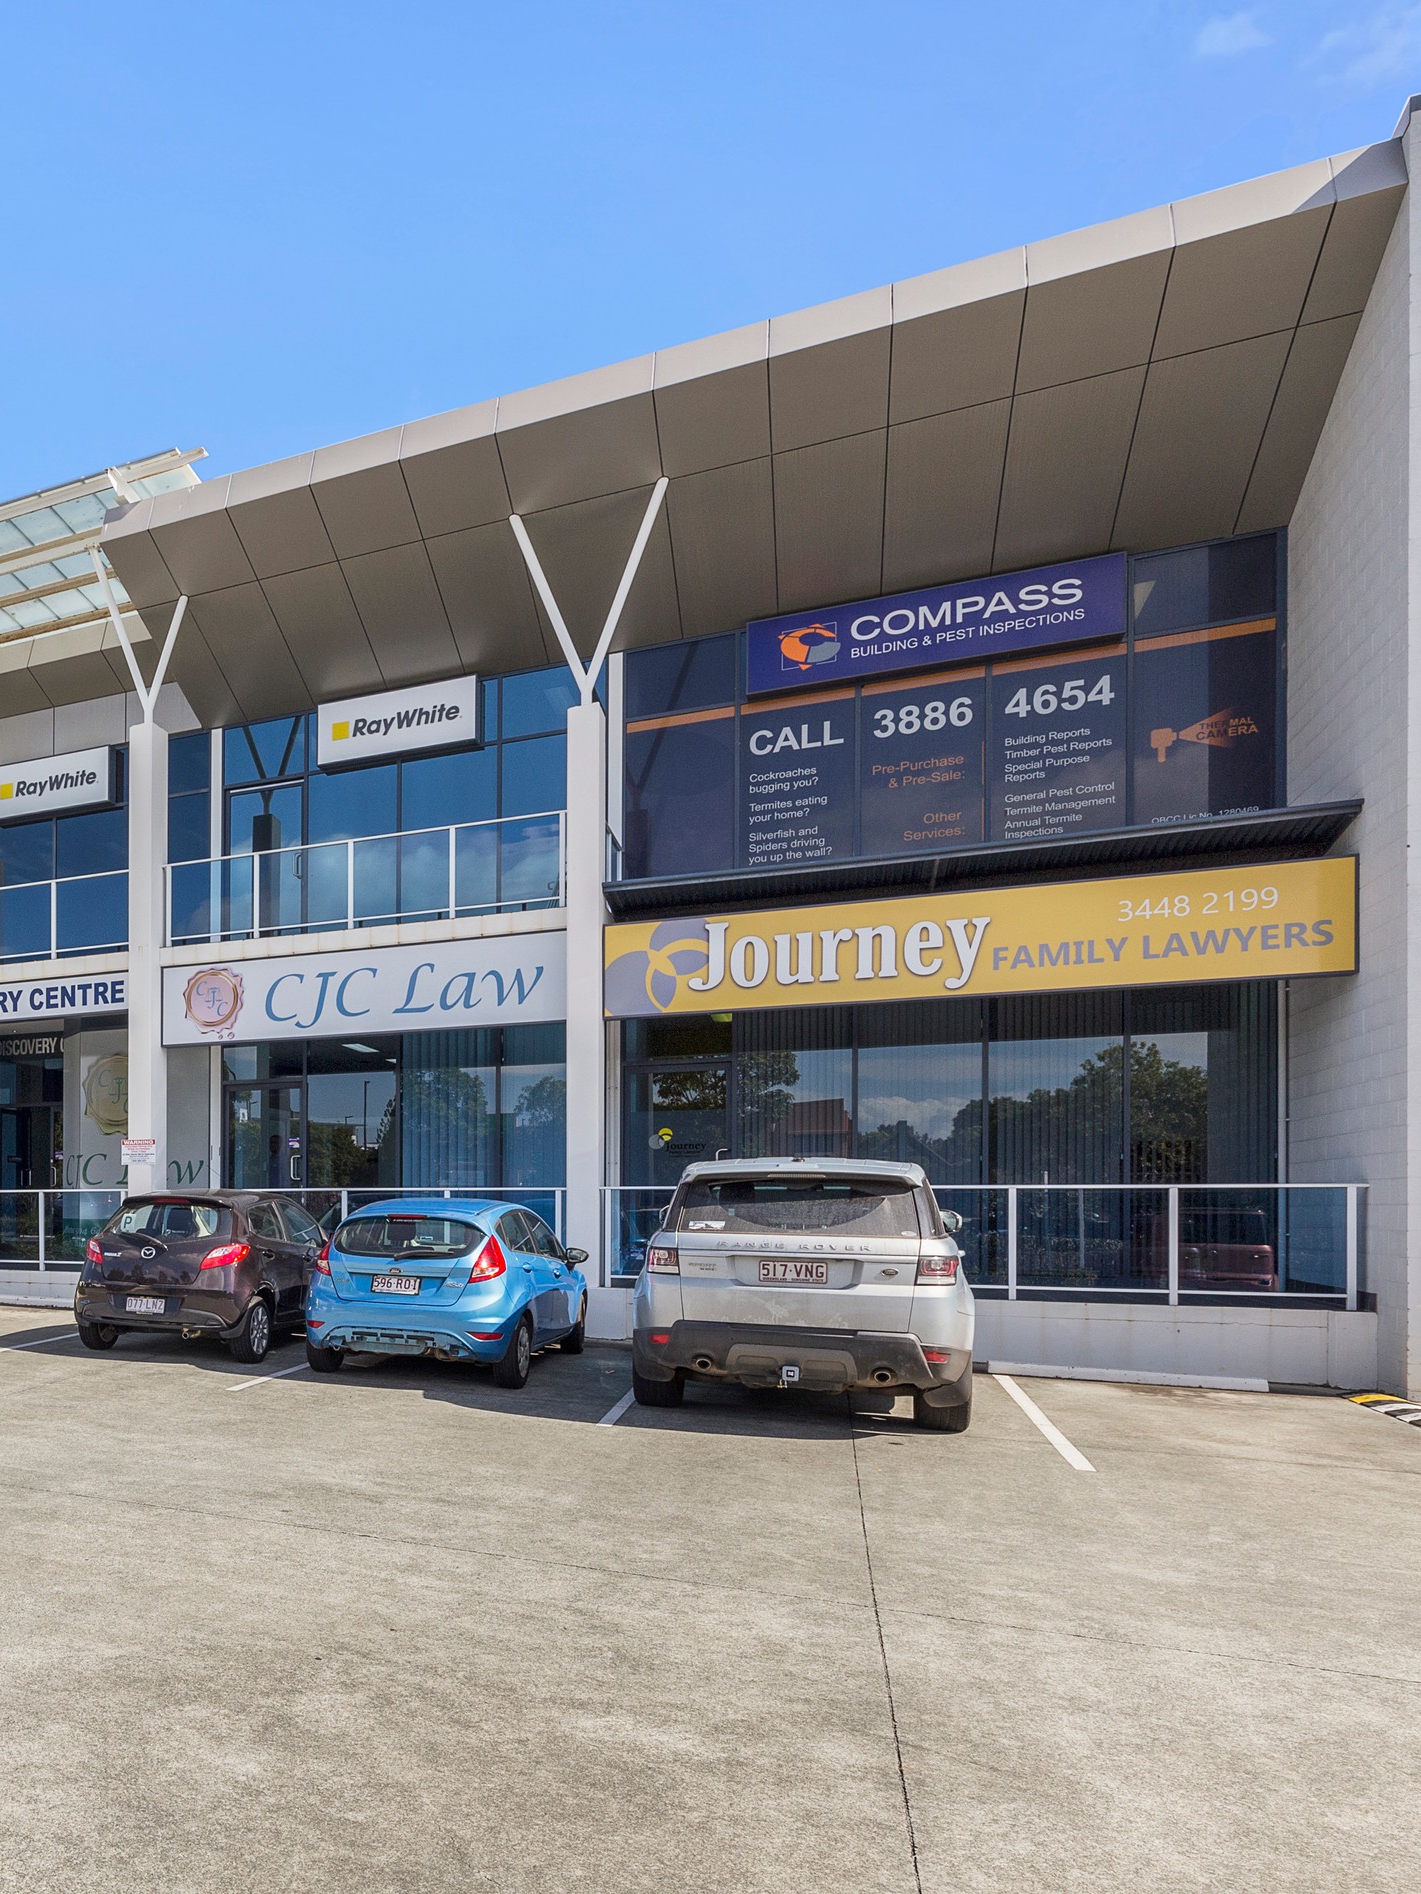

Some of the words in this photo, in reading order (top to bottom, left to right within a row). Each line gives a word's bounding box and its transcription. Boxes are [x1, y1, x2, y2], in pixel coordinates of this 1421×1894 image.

[851, 578, 1083, 641] COMPASS
[851, 637, 918, 658] BUILDING
[922, 635, 932, 646] &
[936, 627, 975, 644] PEST
[979, 608, 1085, 637] INSPECTIONS
[1005, 675, 1115, 718] 4654
[352, 703, 461, 738] RayWhite
[873, 697, 973, 739] 3886
[749, 721, 844, 756] CALL
[1005, 734, 1046, 747] Building
[1049, 728, 1091, 741] Reports
[1005, 748, 1041, 759] Timber
[1044, 743, 1067, 755] Pest
[1070, 738, 1112, 751] Reports
[872, 754, 965, 776] Pre-Purchase
[1005, 761, 1043, 773] Special
[1046, 755, 1090, 768] Purpose
[15, 768, 98, 798] RayWhite
[749, 767, 817, 783] Cockroaches
[888, 777, 899, 789] &
[902, 770, 966, 787] Pre-Sale:
[1005, 770, 1046, 783] Reports
[749, 781, 790, 794] bugging
[793, 776, 819, 791] you?
[1005, 789, 1046, 803] General
[1049, 786, 1073, 798] Pest
[1076, 781, 1115, 794] Control
[749, 799, 793, 812] Termites
[796, 796, 828, 808] eating
[1005, 804, 1043, 816] Termite
[1045, 795, 1116, 812] Management
[749, 813, 772, 825] your
[774, 808, 810, 821] home?
[923, 811, 962, 824] Other
[1005, 817, 1041, 829] Annual
[1044, 813, 1083, 825] Termite
[749, 828, 796, 842] Silverfish
[798, 826, 818, 837] and
[903, 826, 965, 842] Services:
[1005, 826, 1064, 840] Inspections
[749, 840, 788, 853] Spiders
[791, 837, 826, 850] driving
[749, 855, 768, 865] you
[770, 853, 784, 863] up
[786, 850, 803, 860] the
[805, 846, 833, 858] wall?
[1117, 895, 1191, 922] 3448
[1202, 886, 1279, 914] 2199
[688, 916, 991, 991] Journey
[992, 936, 1128, 971] FAMILY
[1143, 919, 1334, 960] LAWYERS
[30, 979, 125, 1011] CENTRE
[265, 967, 378, 1029] CJC
[392, 962, 545, 1015] Law
[665, 1142, 706, 1152] Journey
[123, 1216, 133, 1229] P
[717, 1240, 786, 1250] RANGE
[799, 1243, 871, 1252] ROVER
